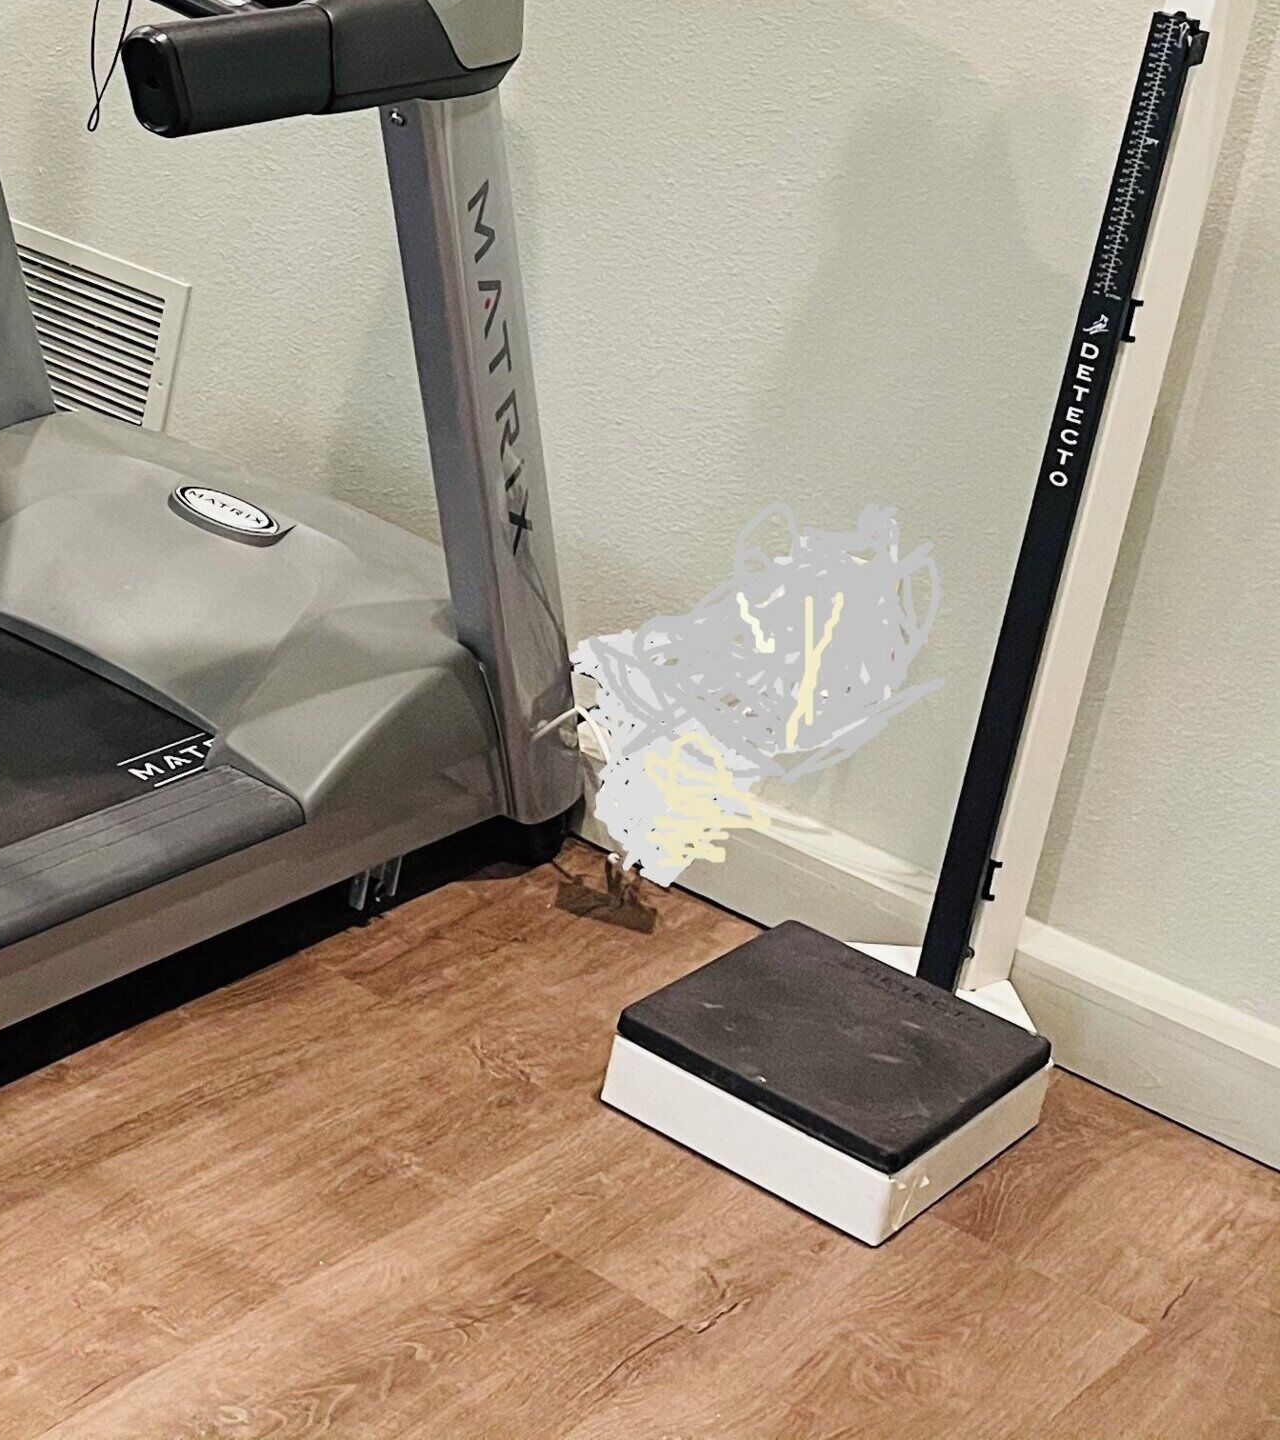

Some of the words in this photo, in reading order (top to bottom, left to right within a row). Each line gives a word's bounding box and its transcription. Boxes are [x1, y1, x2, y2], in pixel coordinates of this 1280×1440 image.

[467, 178, 533, 557] MATRIX
[1048, 341, 1100, 487] DETECTO
[188, 490, 263, 524] MATRIX
